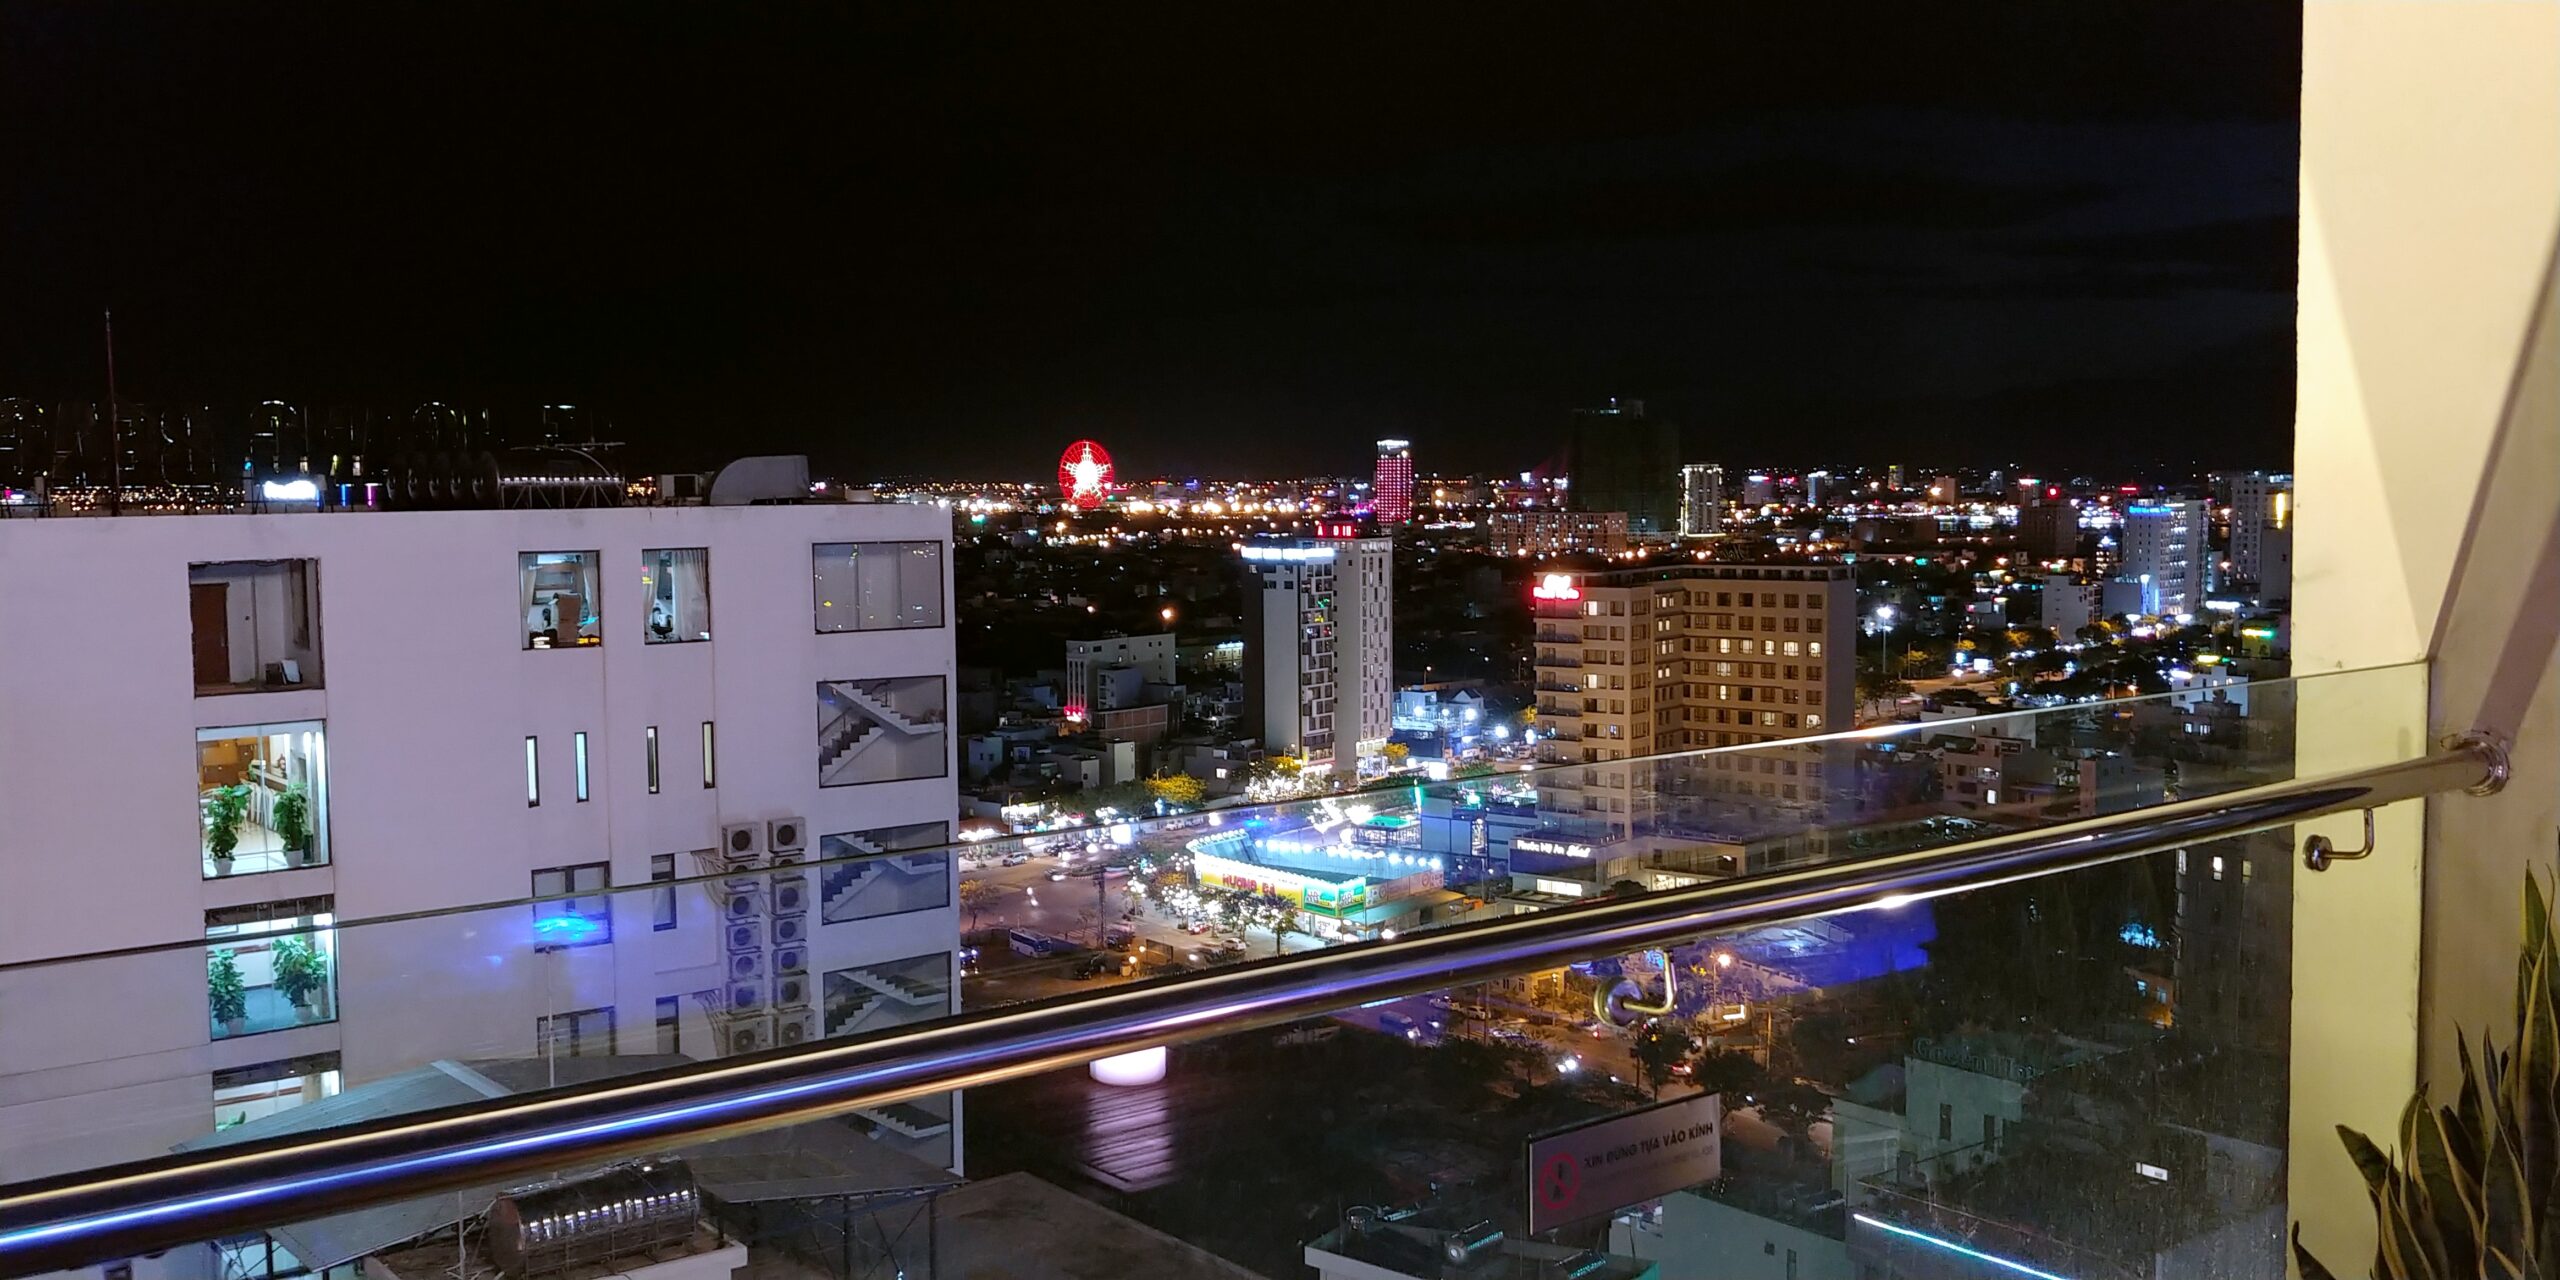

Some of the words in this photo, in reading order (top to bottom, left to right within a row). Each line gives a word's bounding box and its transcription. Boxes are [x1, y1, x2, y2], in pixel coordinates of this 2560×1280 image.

[1583, 1153, 1603, 1168] XIN
[1662, 1129, 1686, 1147] VÀO
[1688, 1122, 1713, 1140] KÍNH
